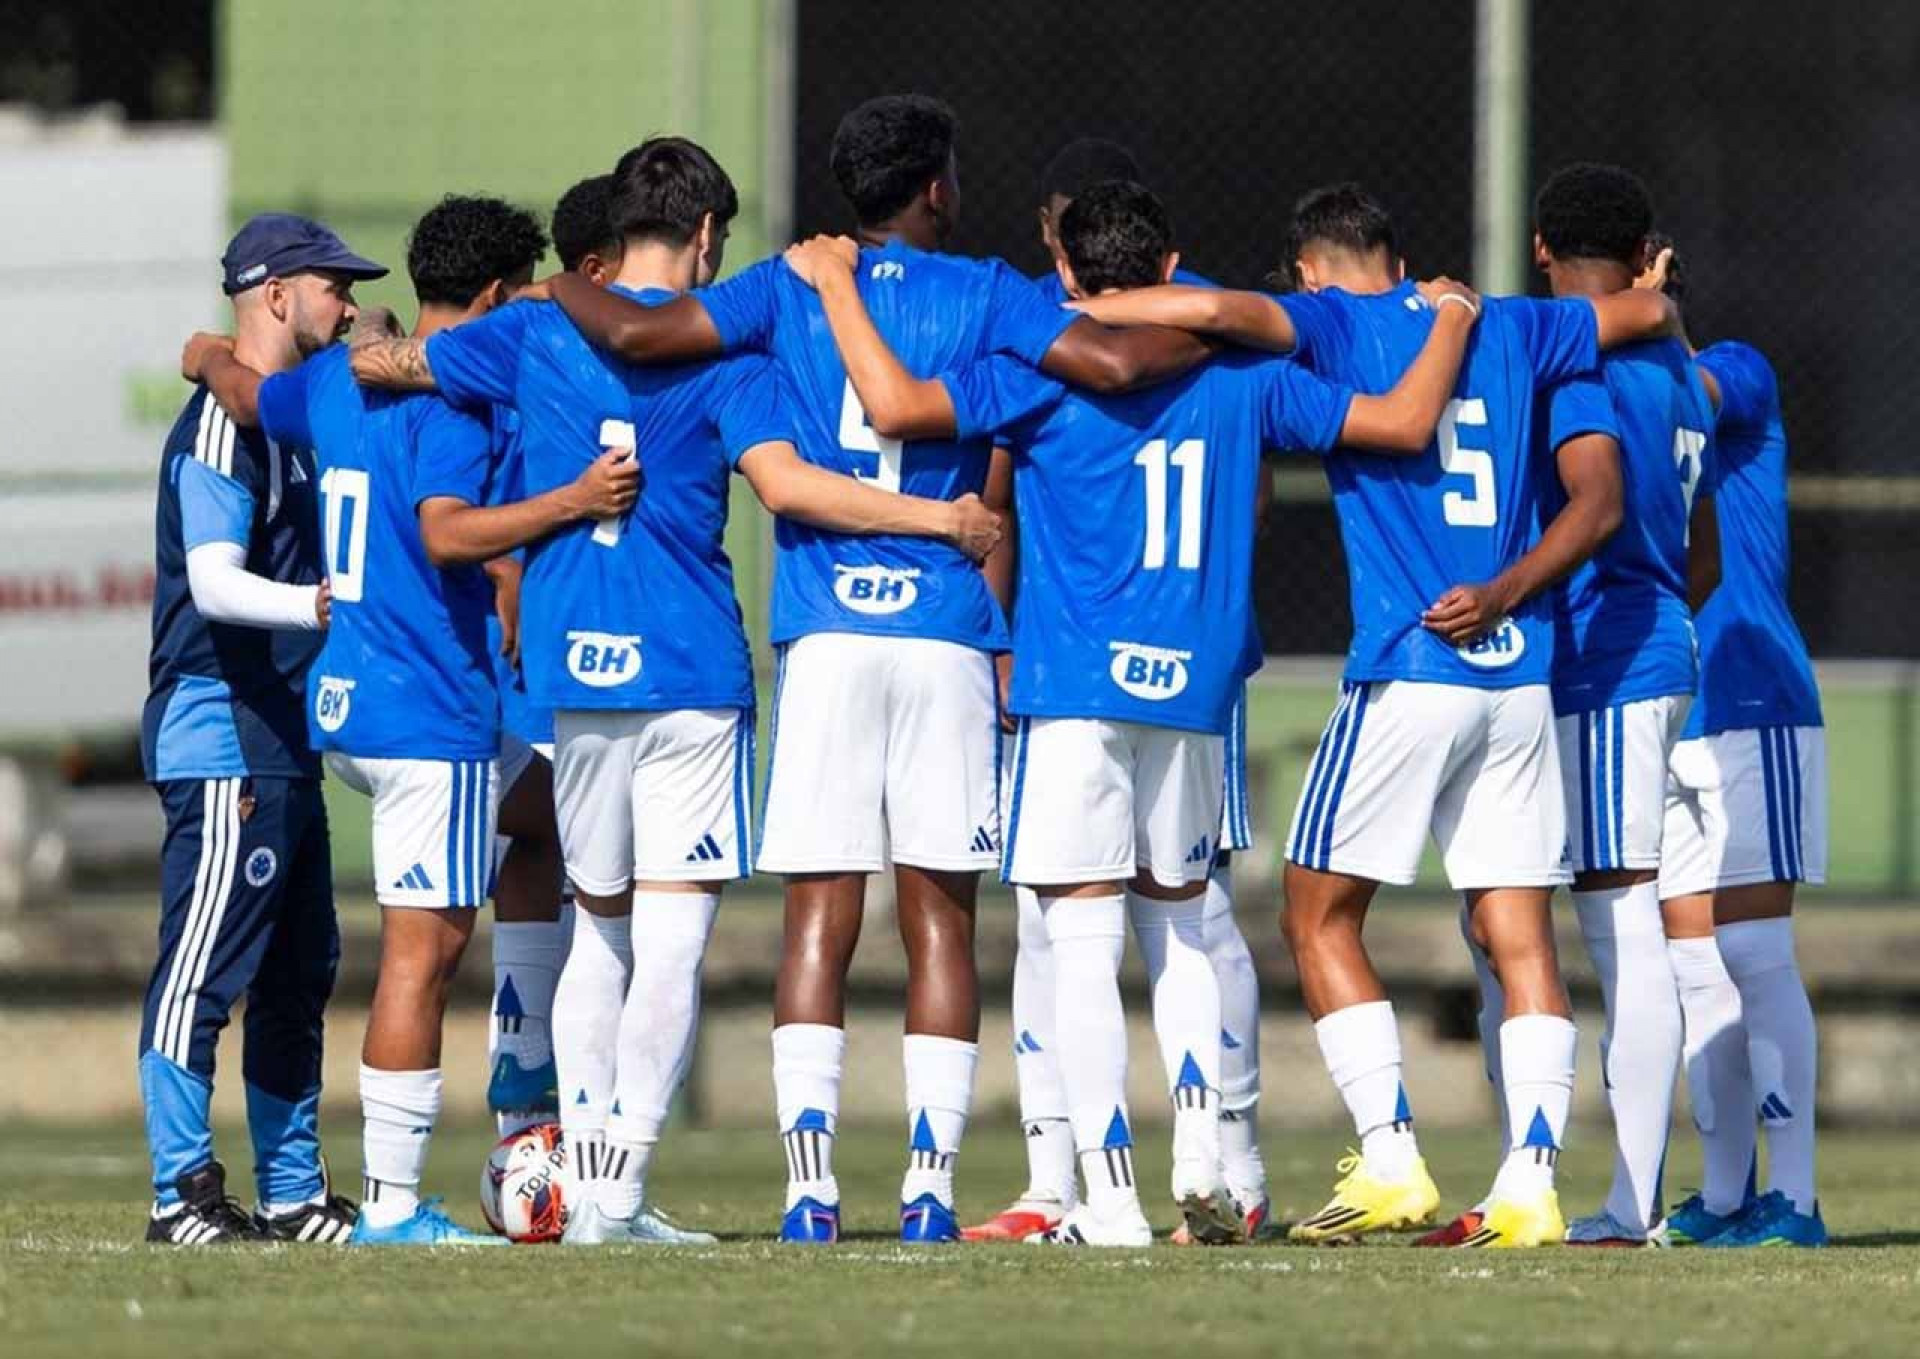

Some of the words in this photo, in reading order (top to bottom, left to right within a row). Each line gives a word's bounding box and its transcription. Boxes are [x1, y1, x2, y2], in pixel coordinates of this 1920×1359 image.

[1437, 398, 1498, 527] 5
[1133, 438, 1206, 569] 11
[320, 467, 370, 603] 10
[849, 577, 904, 602] BH
[579, 644, 630, 674] BH
[1124, 655, 1177, 689] BH
[320, 689, 346, 721] BH
